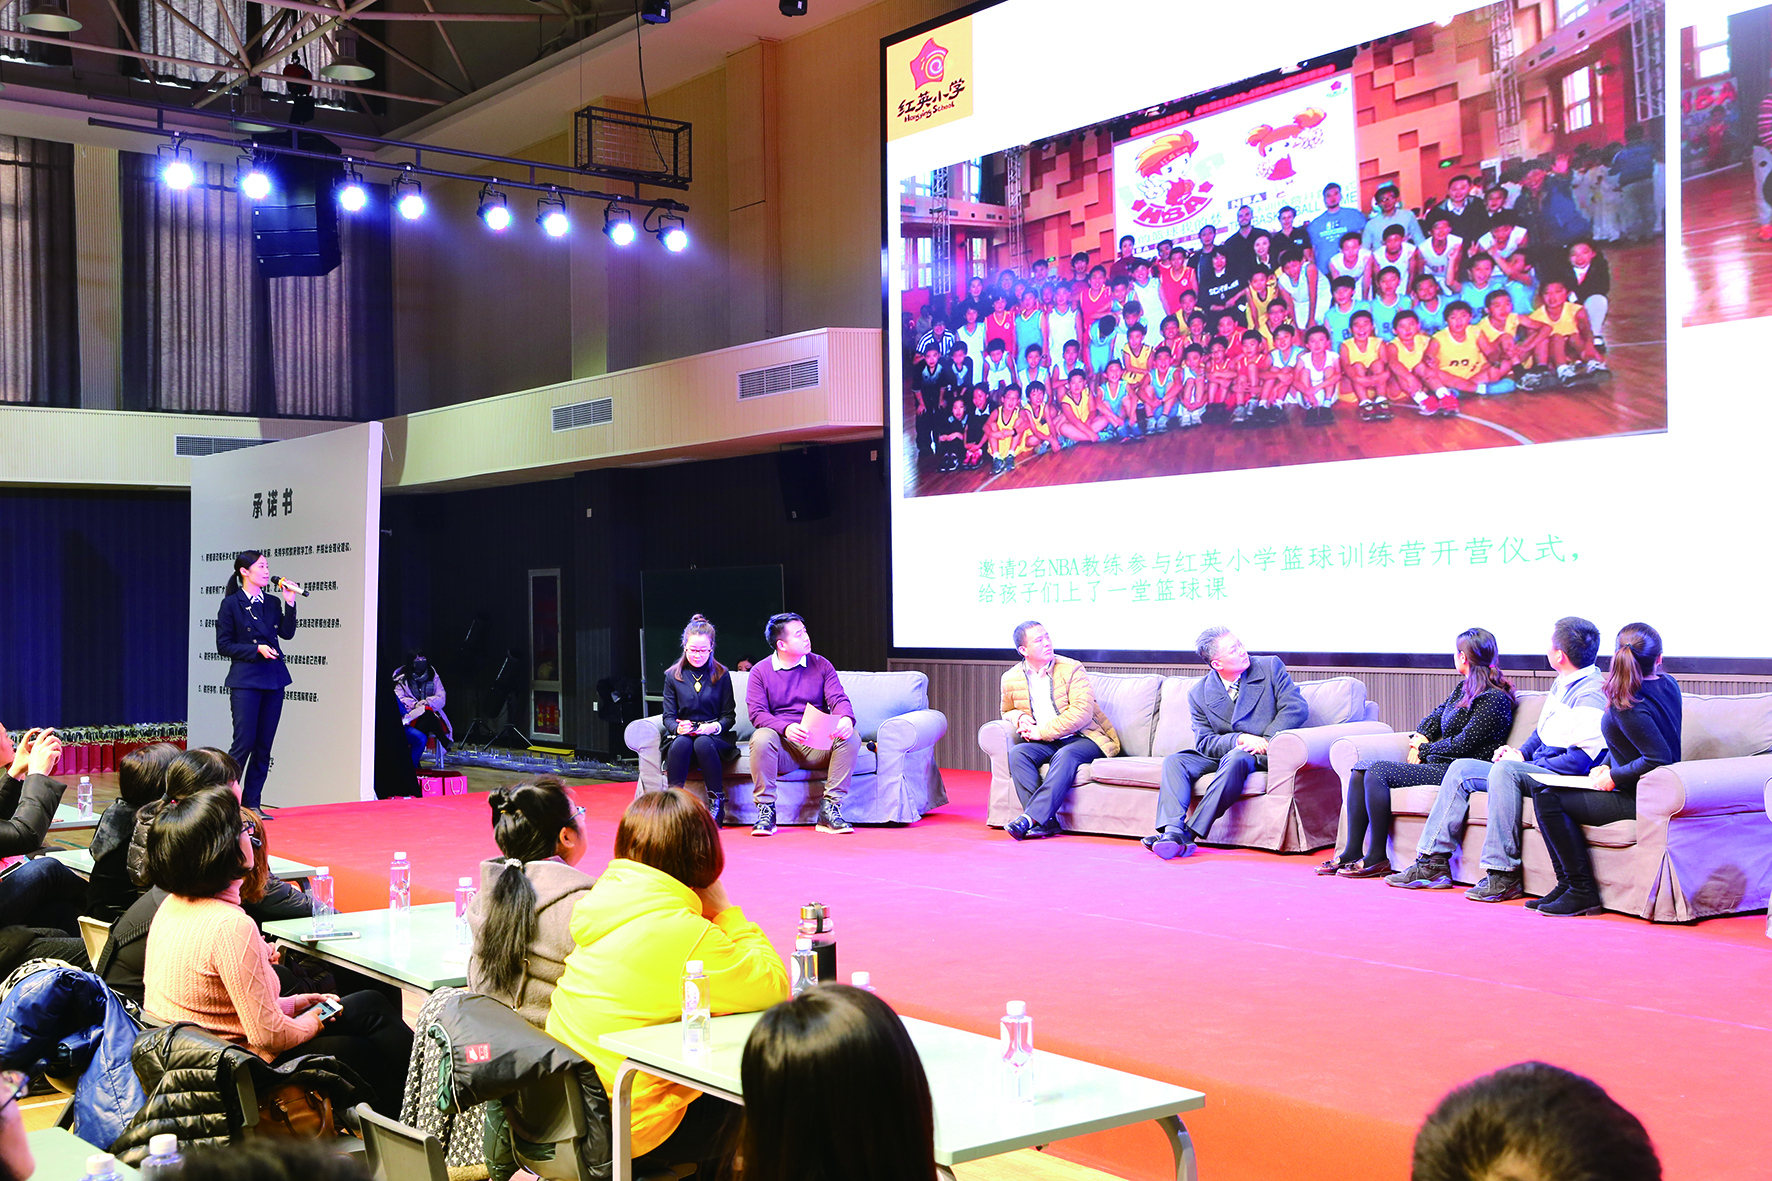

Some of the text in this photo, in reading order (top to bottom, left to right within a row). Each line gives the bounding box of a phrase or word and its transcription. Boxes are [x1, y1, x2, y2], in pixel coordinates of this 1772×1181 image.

[897, 77, 966, 117] 红英小学
[932, 101, 955, 114] School
[1136, 195, 1209, 225] NBA
[252, 487, 293, 519] 承诺书
[978, 577, 1229, 605] 给孩子们上了一堂篮球课
